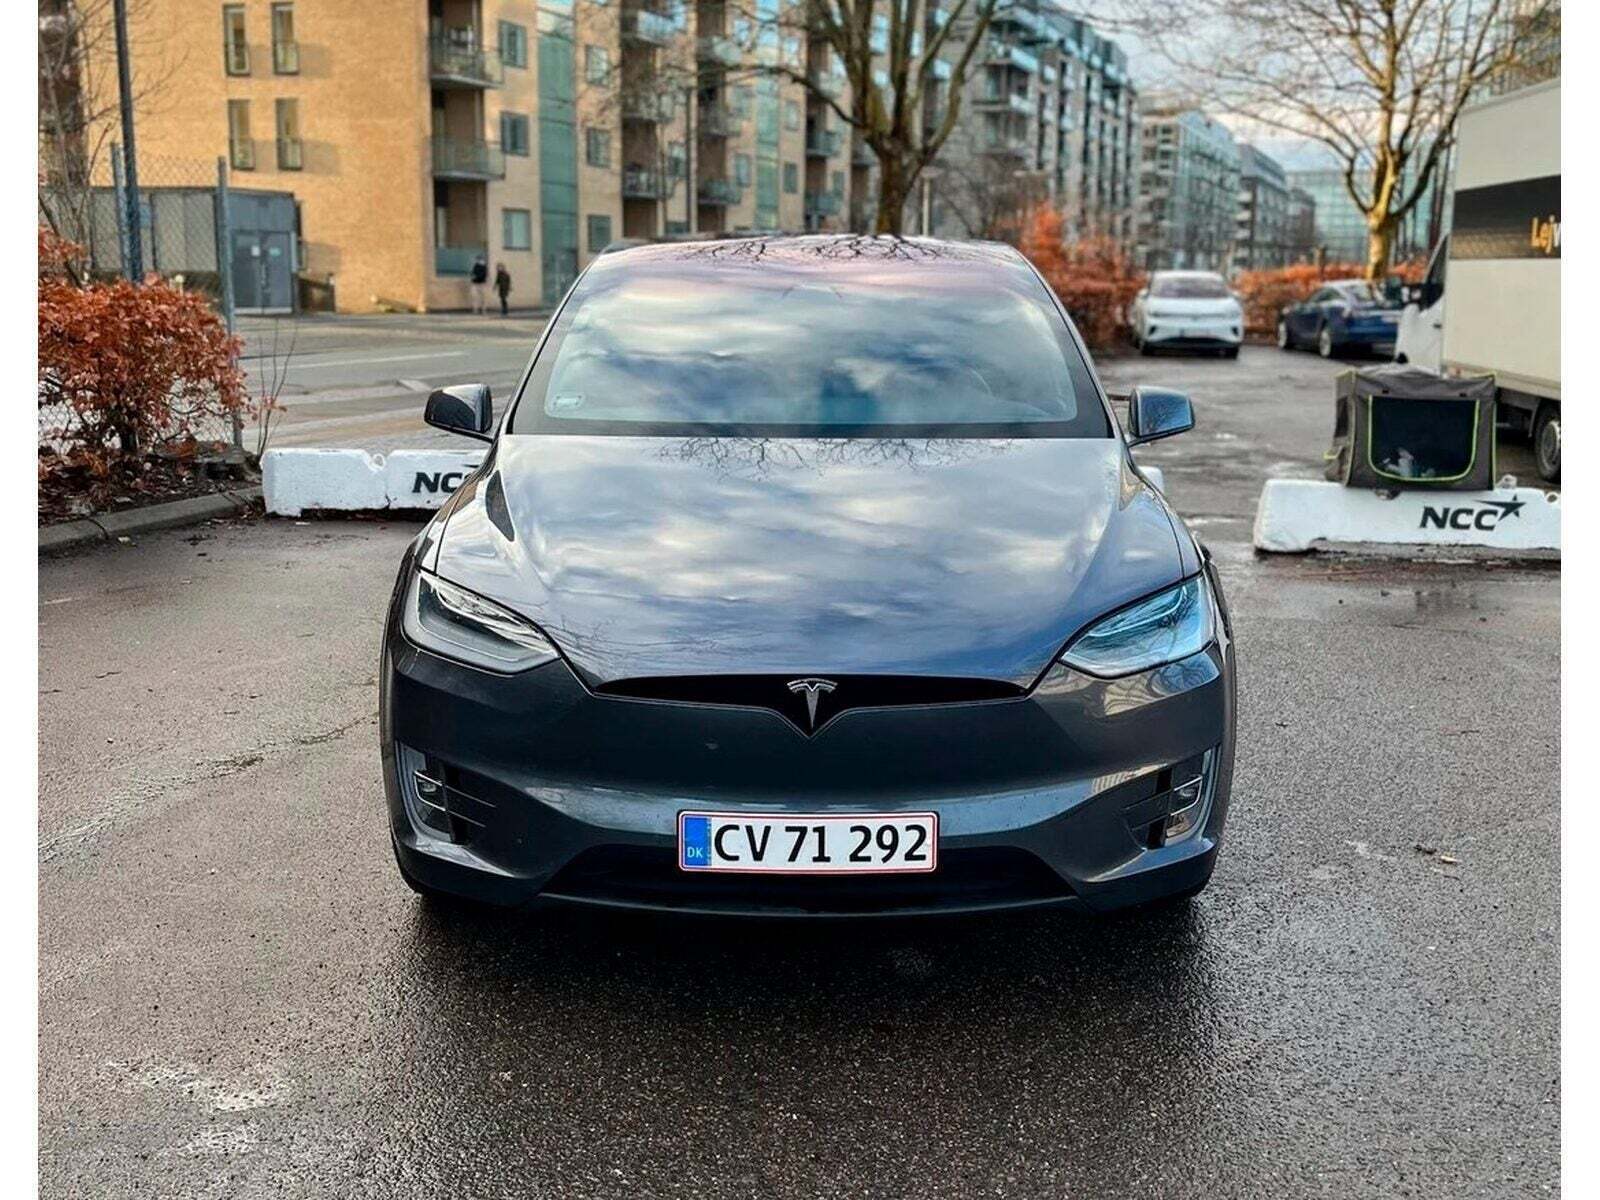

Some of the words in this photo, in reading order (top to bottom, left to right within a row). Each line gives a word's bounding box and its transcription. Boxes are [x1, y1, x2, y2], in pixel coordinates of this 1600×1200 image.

[412, 472, 471, 493] NC
[1419, 506, 1498, 531] NCC
[687, 847, 703, 858] DK
[714, 824, 771, 861] CV
[785, 826, 831, 862] 71
[849, 824, 927, 863] 292
